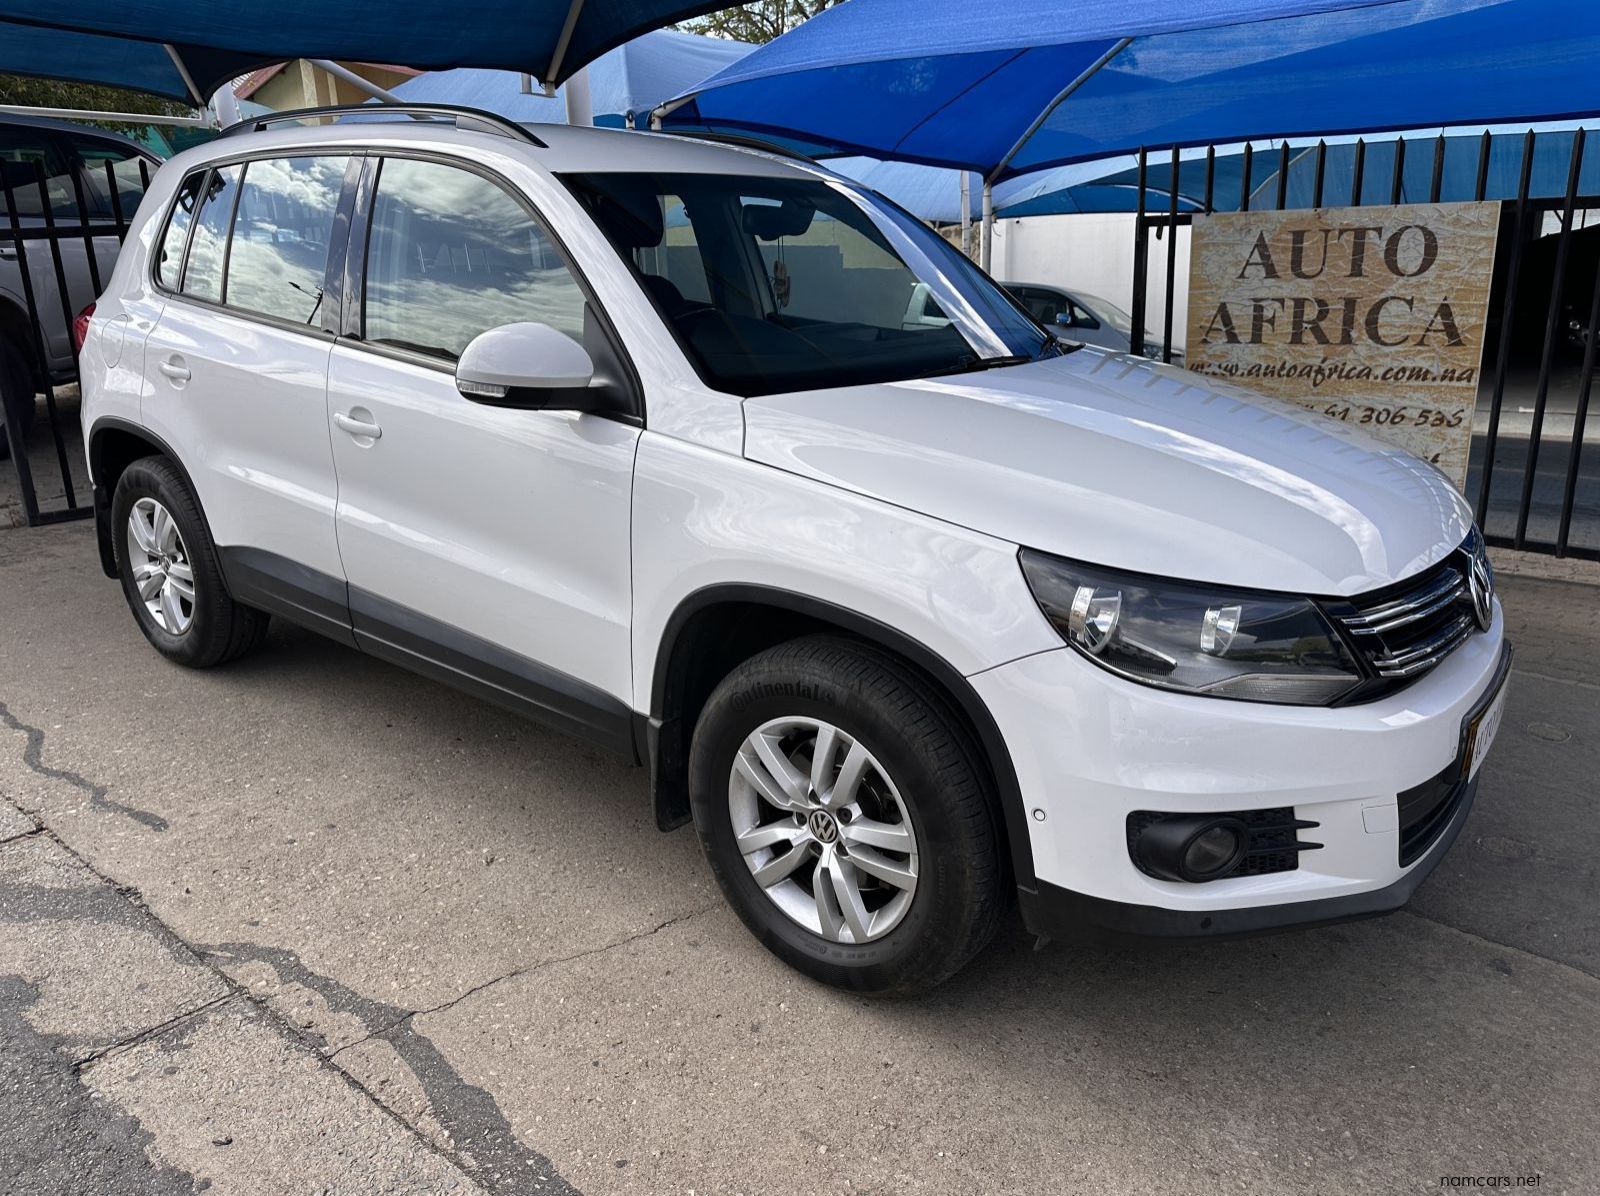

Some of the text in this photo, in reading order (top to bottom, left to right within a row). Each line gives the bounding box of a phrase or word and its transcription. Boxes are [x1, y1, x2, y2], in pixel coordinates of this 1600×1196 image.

[1236, 224, 1439, 280] AUTO
[1199, 295, 1467, 347] AFRICA
[1360, 406, 1407, 425] 306
